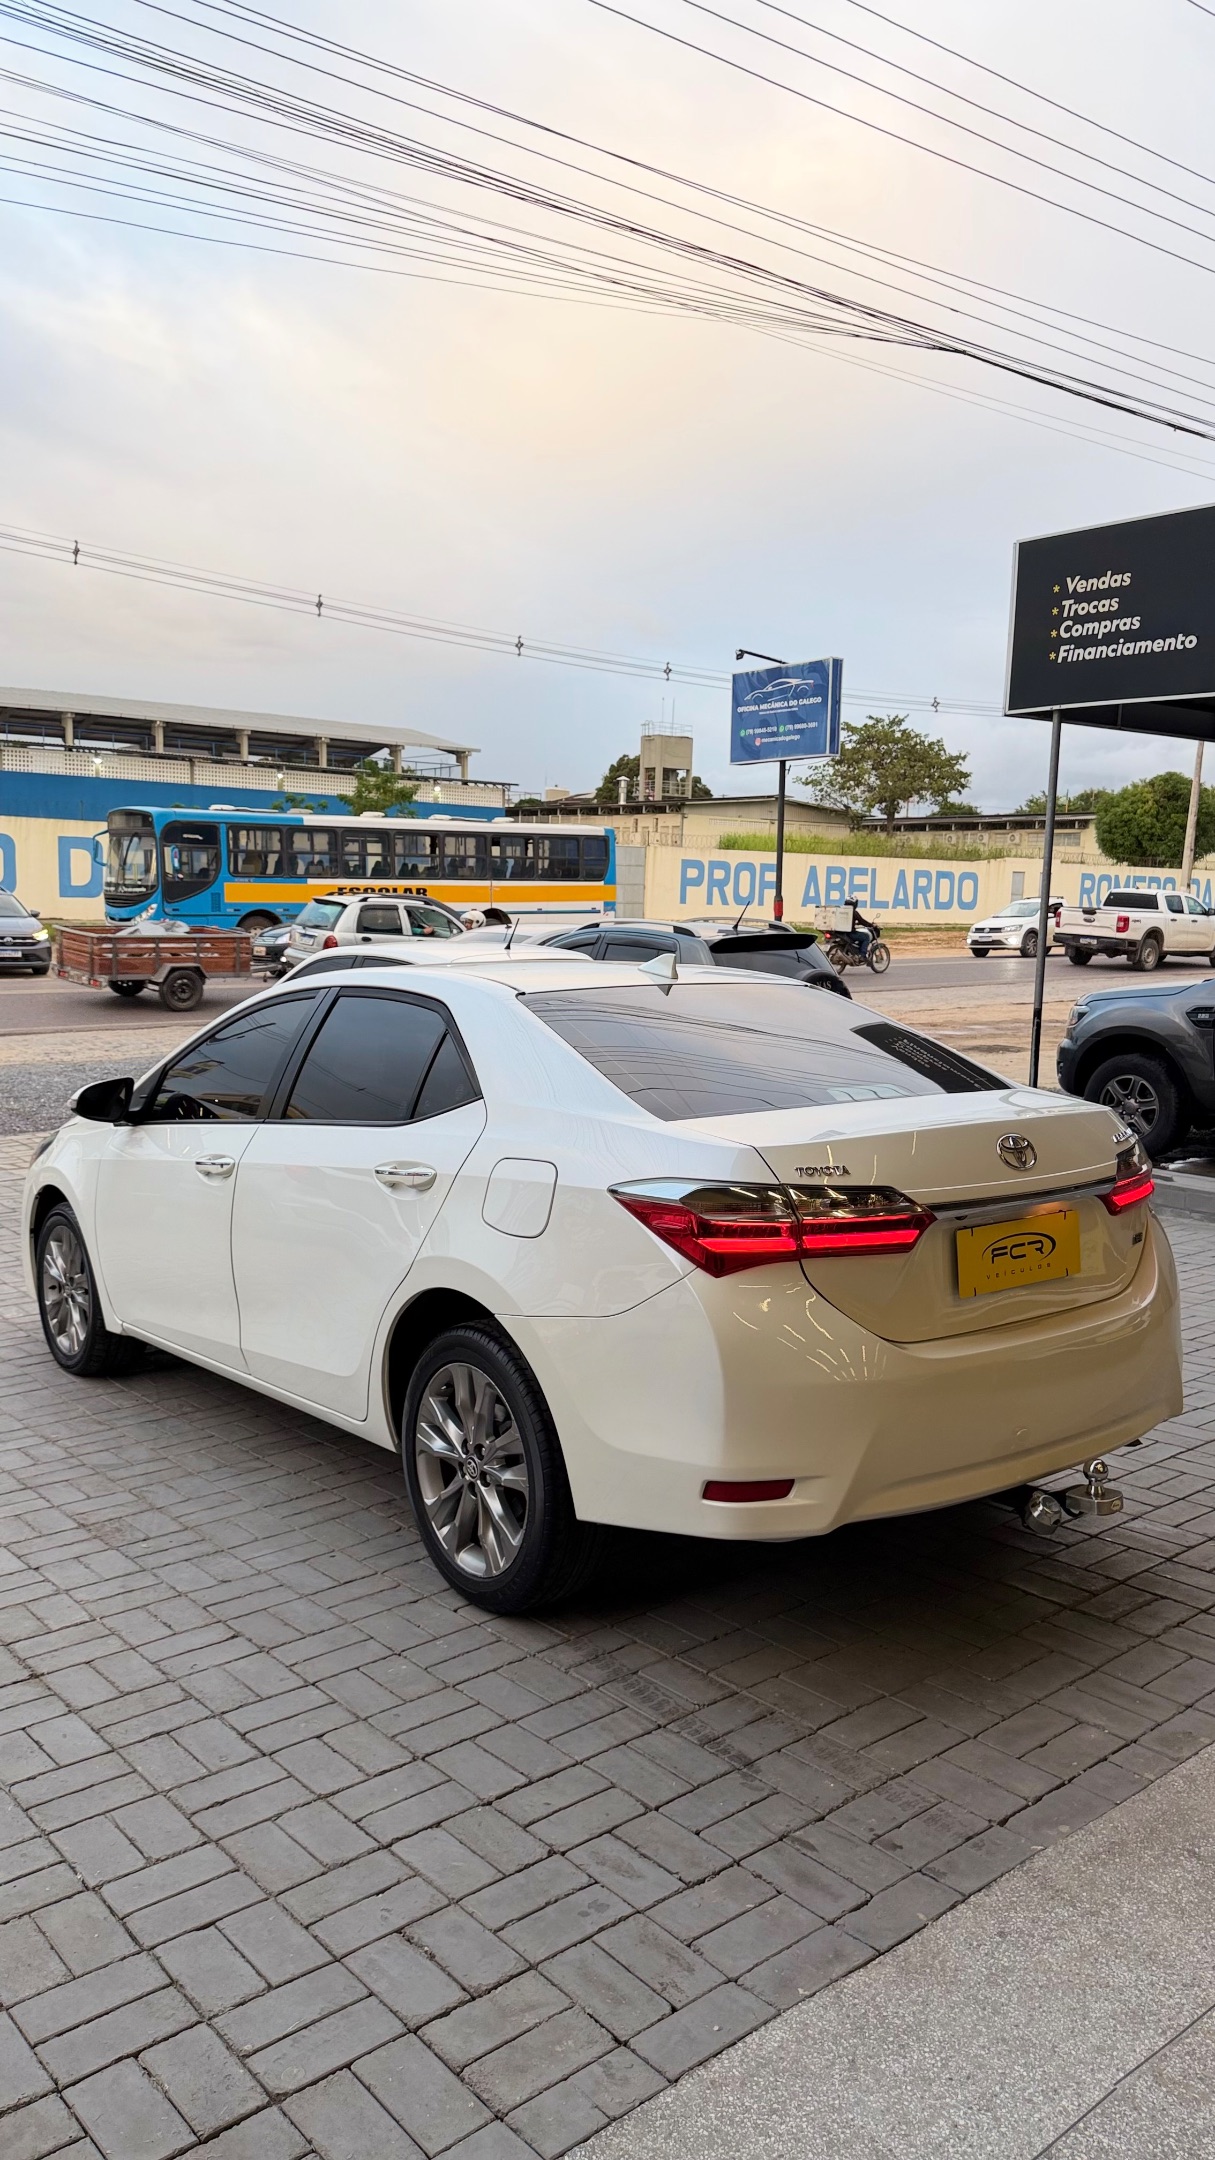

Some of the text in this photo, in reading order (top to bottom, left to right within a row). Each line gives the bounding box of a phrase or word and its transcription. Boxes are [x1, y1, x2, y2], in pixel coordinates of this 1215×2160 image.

[1066, 570, 1132, 595] Vendas
[1061, 596, 1120, 618] Trocas
[1059, 615, 1141, 640] Compras
[1057, 633, 1198, 663] Financiamento
[737, 705, 759, 713] OFICINA
[798, 696, 822, 705] GALEGO
[680, 859, 979, 910] PROF ABELARDO
[794, 1165, 851, 1177] TOYOTA
[991, 1240, 1044, 1264] FCR
